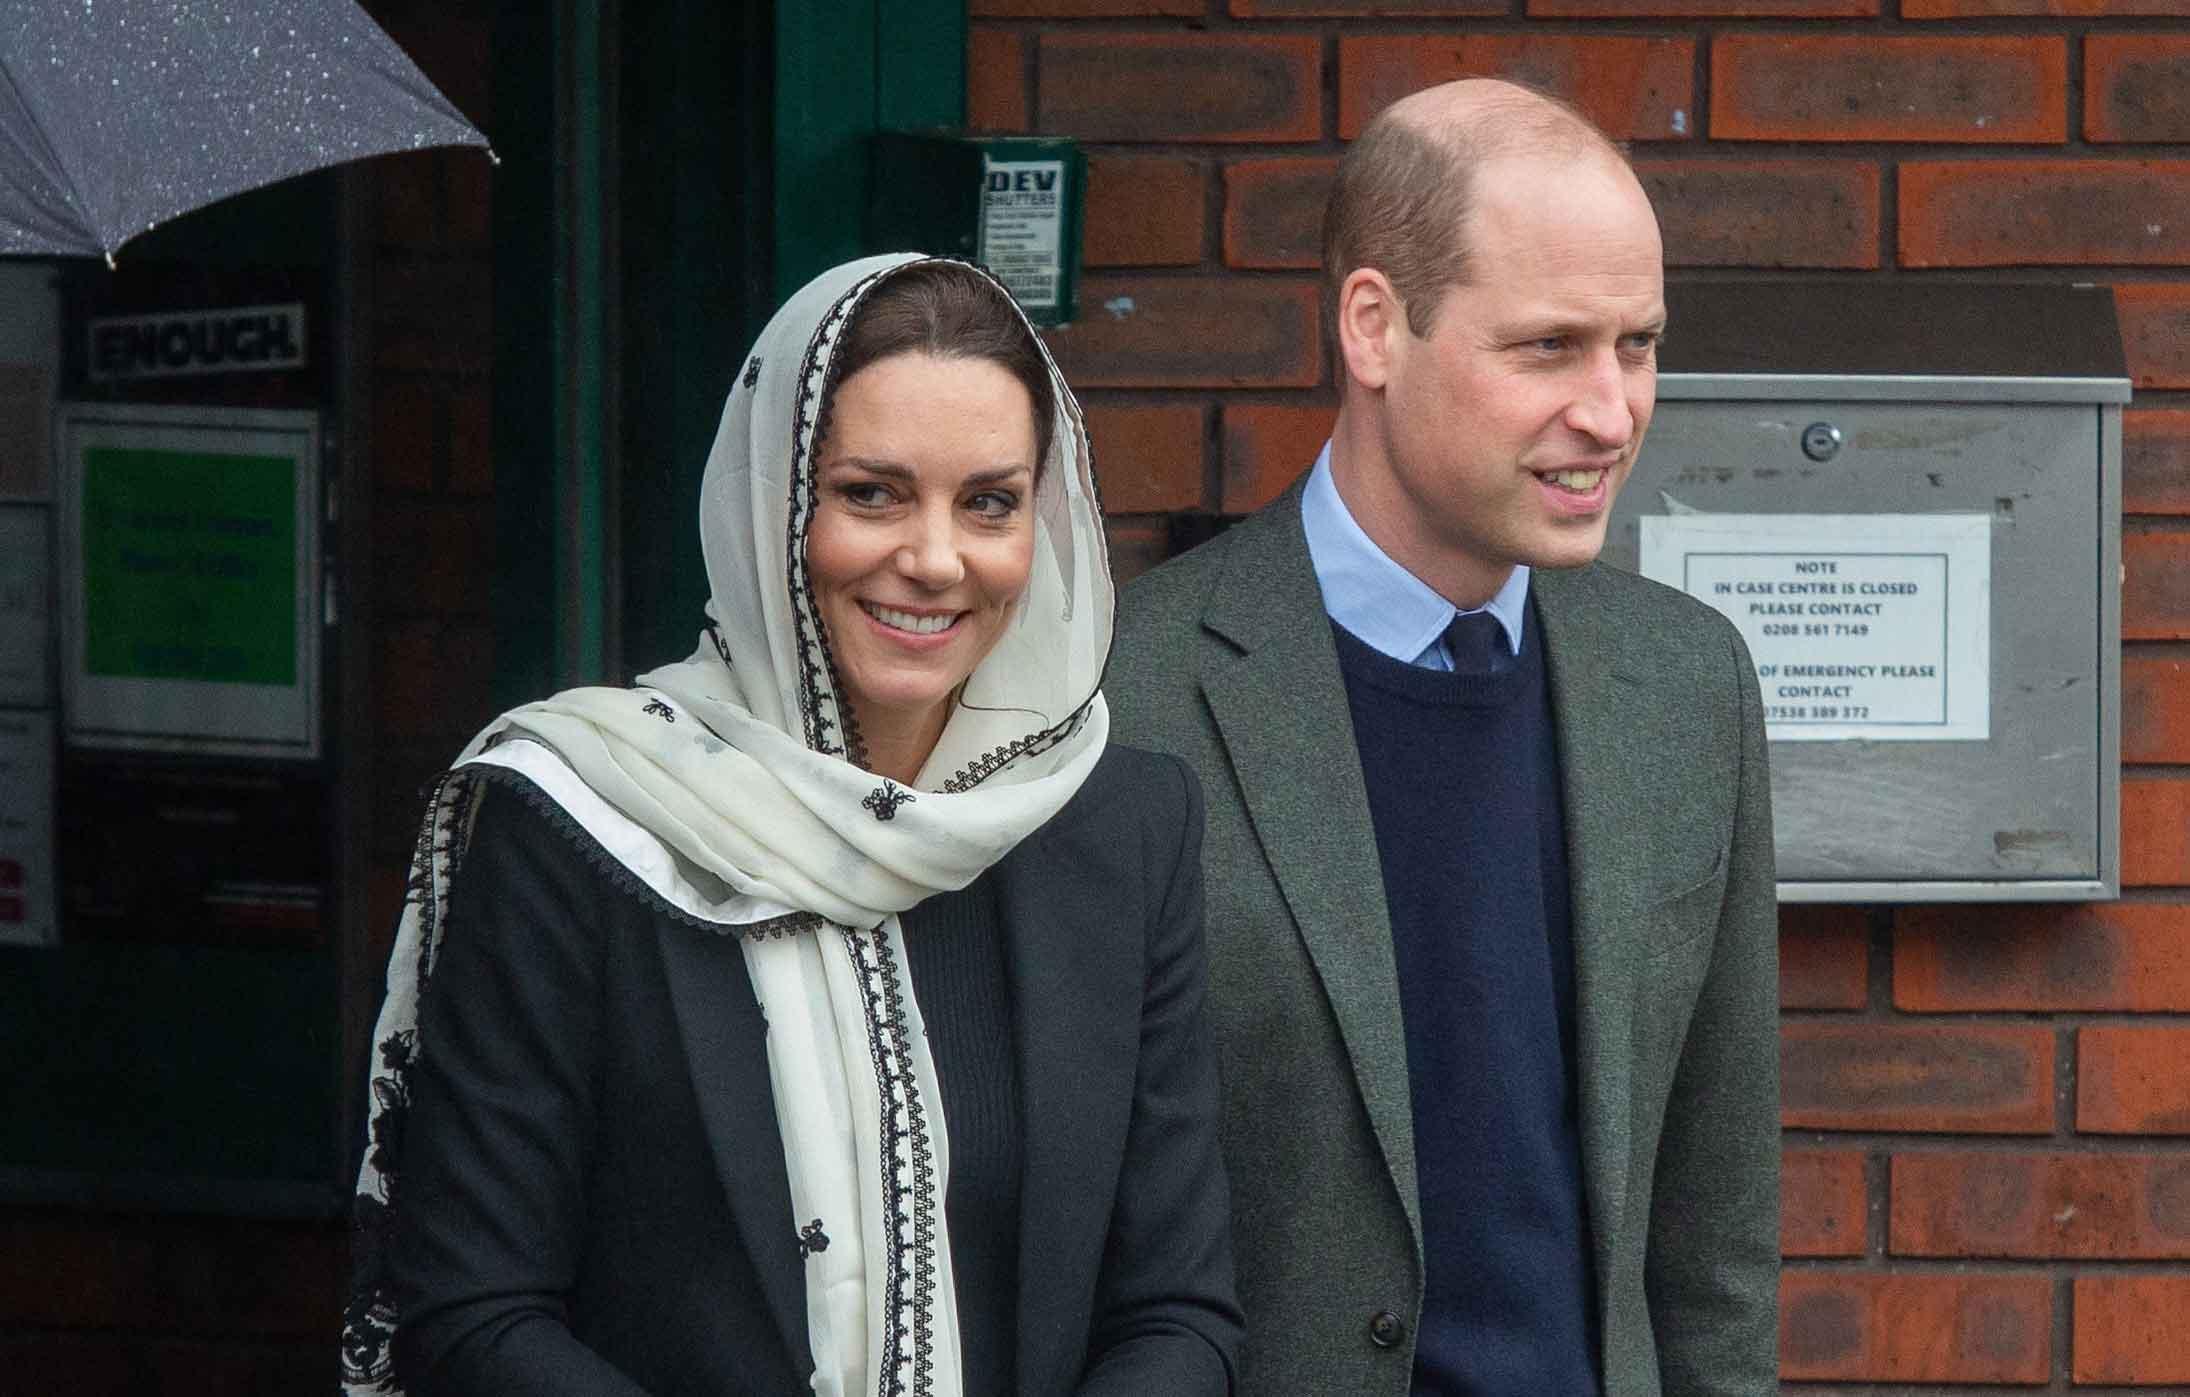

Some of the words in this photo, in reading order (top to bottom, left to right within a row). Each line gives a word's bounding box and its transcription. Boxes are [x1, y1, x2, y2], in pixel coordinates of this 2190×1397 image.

[987, 171, 1057, 191] DEV
[984, 192, 1056, 205] SHUTTERS
[96, 318, 297, 370] ENOUGH.
[1795, 561, 1837, 575] NOTE
[1714, 582, 1732, 596] IN
[1735, 582, 1774, 596] CASE
[1777, 582, 1837, 596] CENTRE
[1841, 582, 1856, 596] IS
[1859, 582, 1918, 596] CLOSED
[1749, 602, 1804, 616] PLEASE
[1808, 602, 1883, 616] CONTACT
[1762, 623, 1799, 637] 0208
[1761, 665, 1778, 679] OF
[1783, 665, 1876, 679] EMERGENCY
[1881, 665, 1935, 679] PLEASE
[1777, 685, 1851, 699] CONTACT
